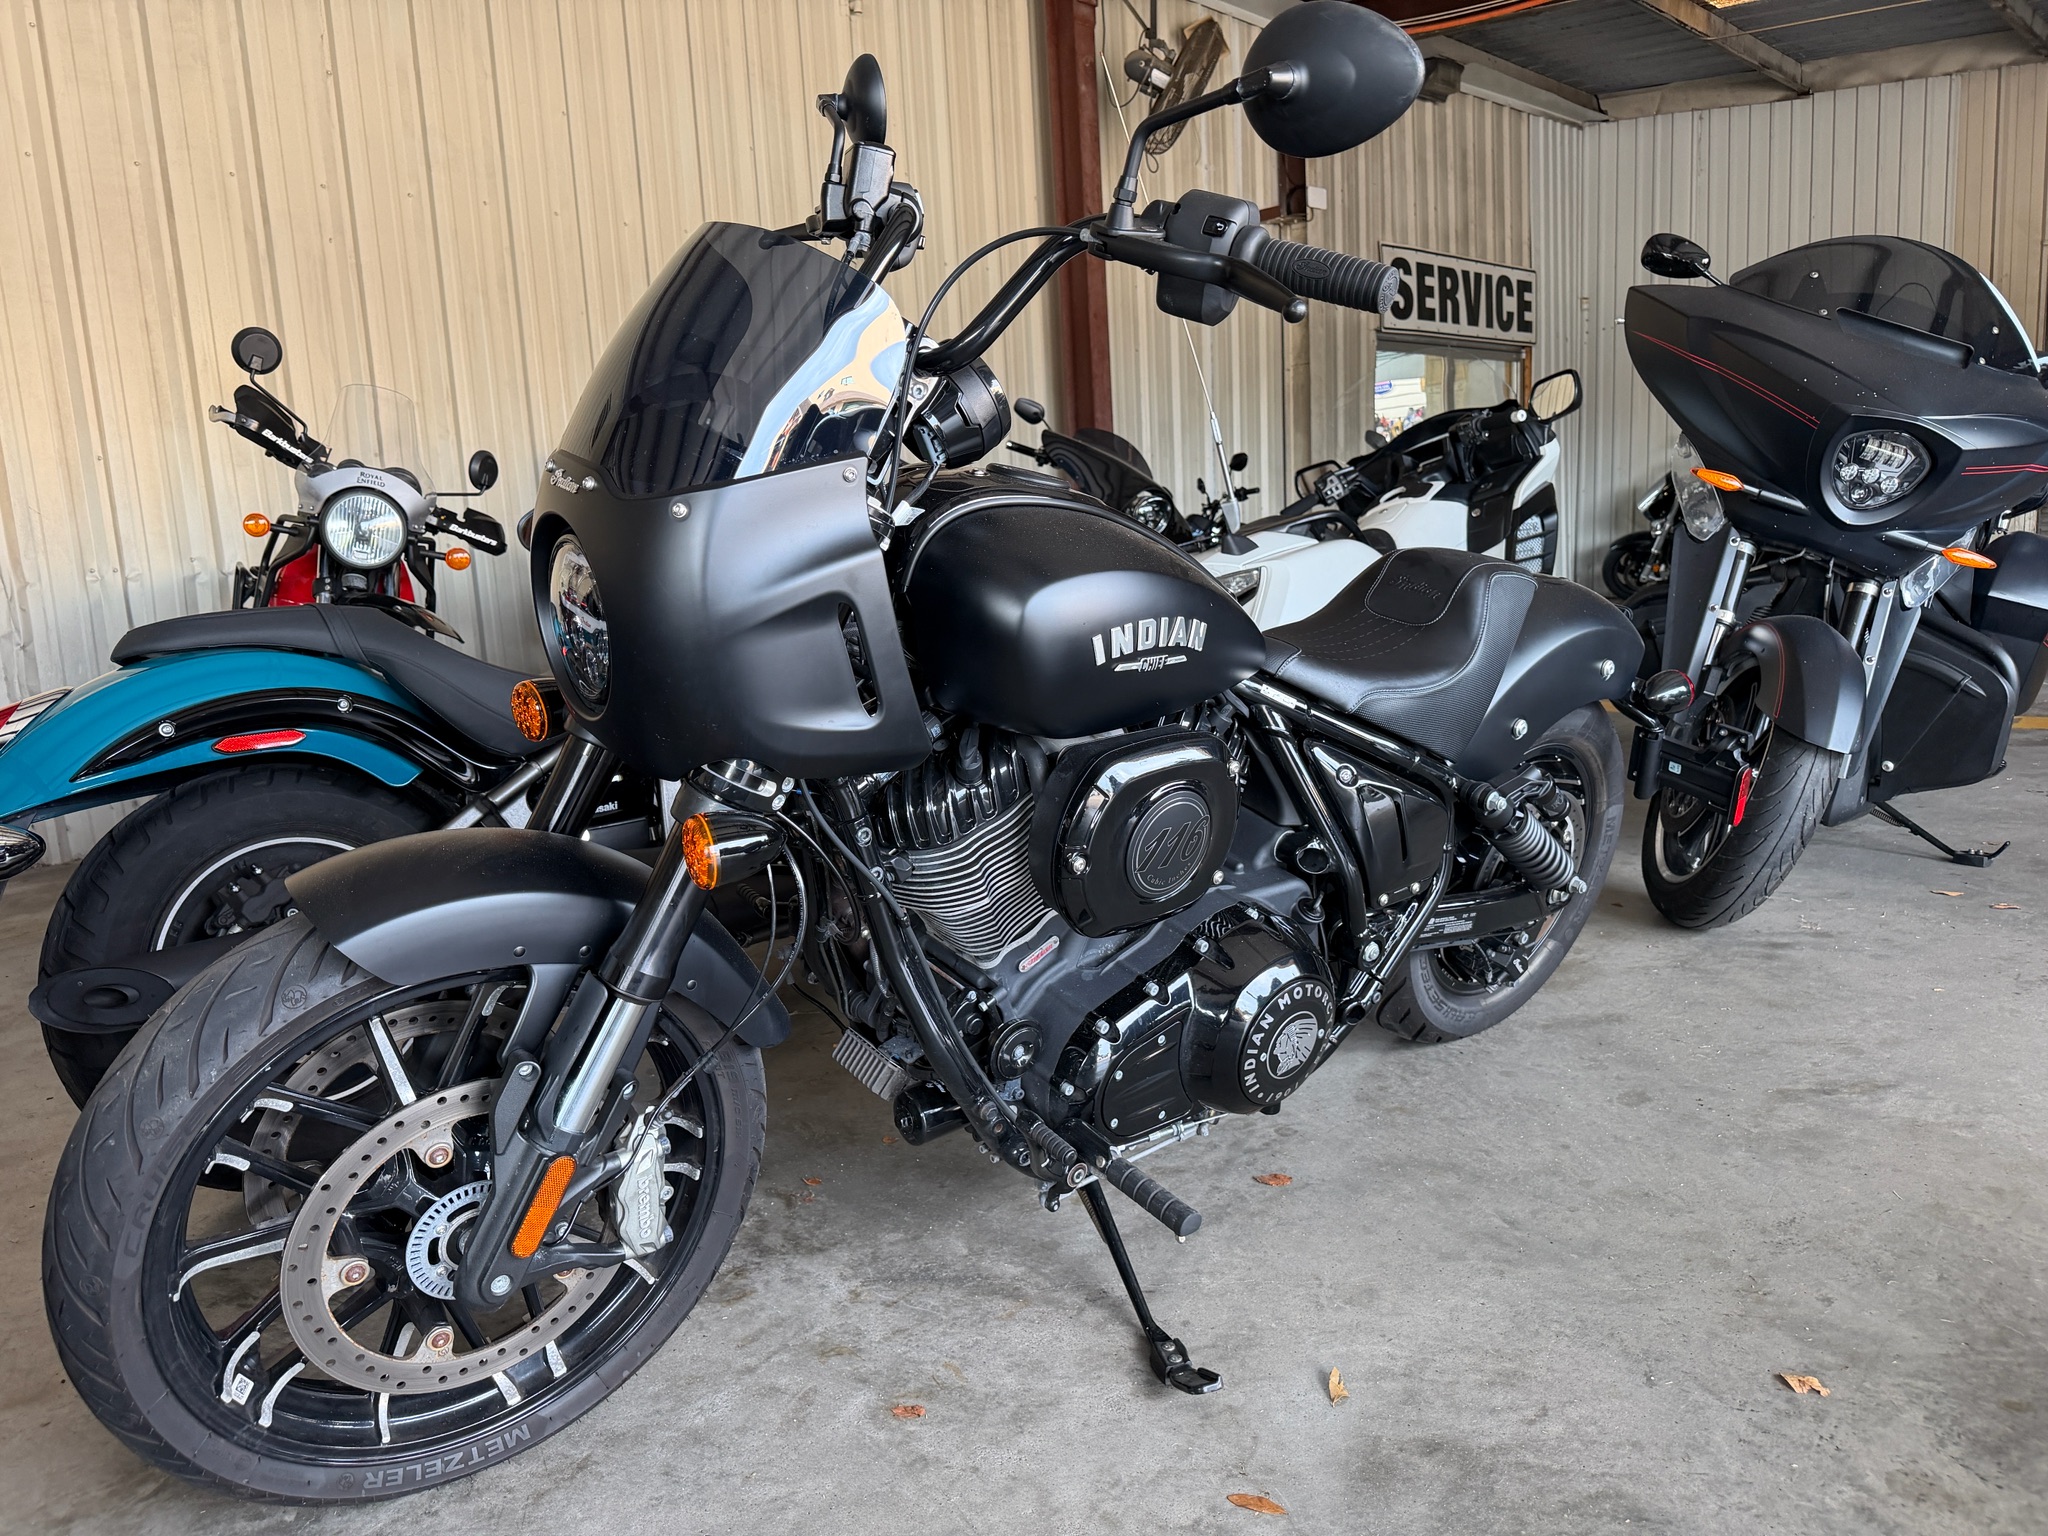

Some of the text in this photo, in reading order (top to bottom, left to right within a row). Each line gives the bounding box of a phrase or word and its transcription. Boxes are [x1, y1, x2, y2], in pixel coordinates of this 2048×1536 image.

[1391, 257, 1533, 333] SERVICE
[261, 429, 314, 463] Barkbusters
[356, 476, 386, 488] ENFIELD
[360, 471, 384, 481] ROYAL
[449, 523, 498, 546] Barkbusters
[1091, 616, 1208, 666] INDIAN
[594, 800, 619, 814] asaki
[1135, 814, 1210, 874] 116
[1244, 1012, 1275, 1094] INDIAN
[637, 1175, 656, 1239] brembo
[363, 1423, 532, 1490] METZELER
